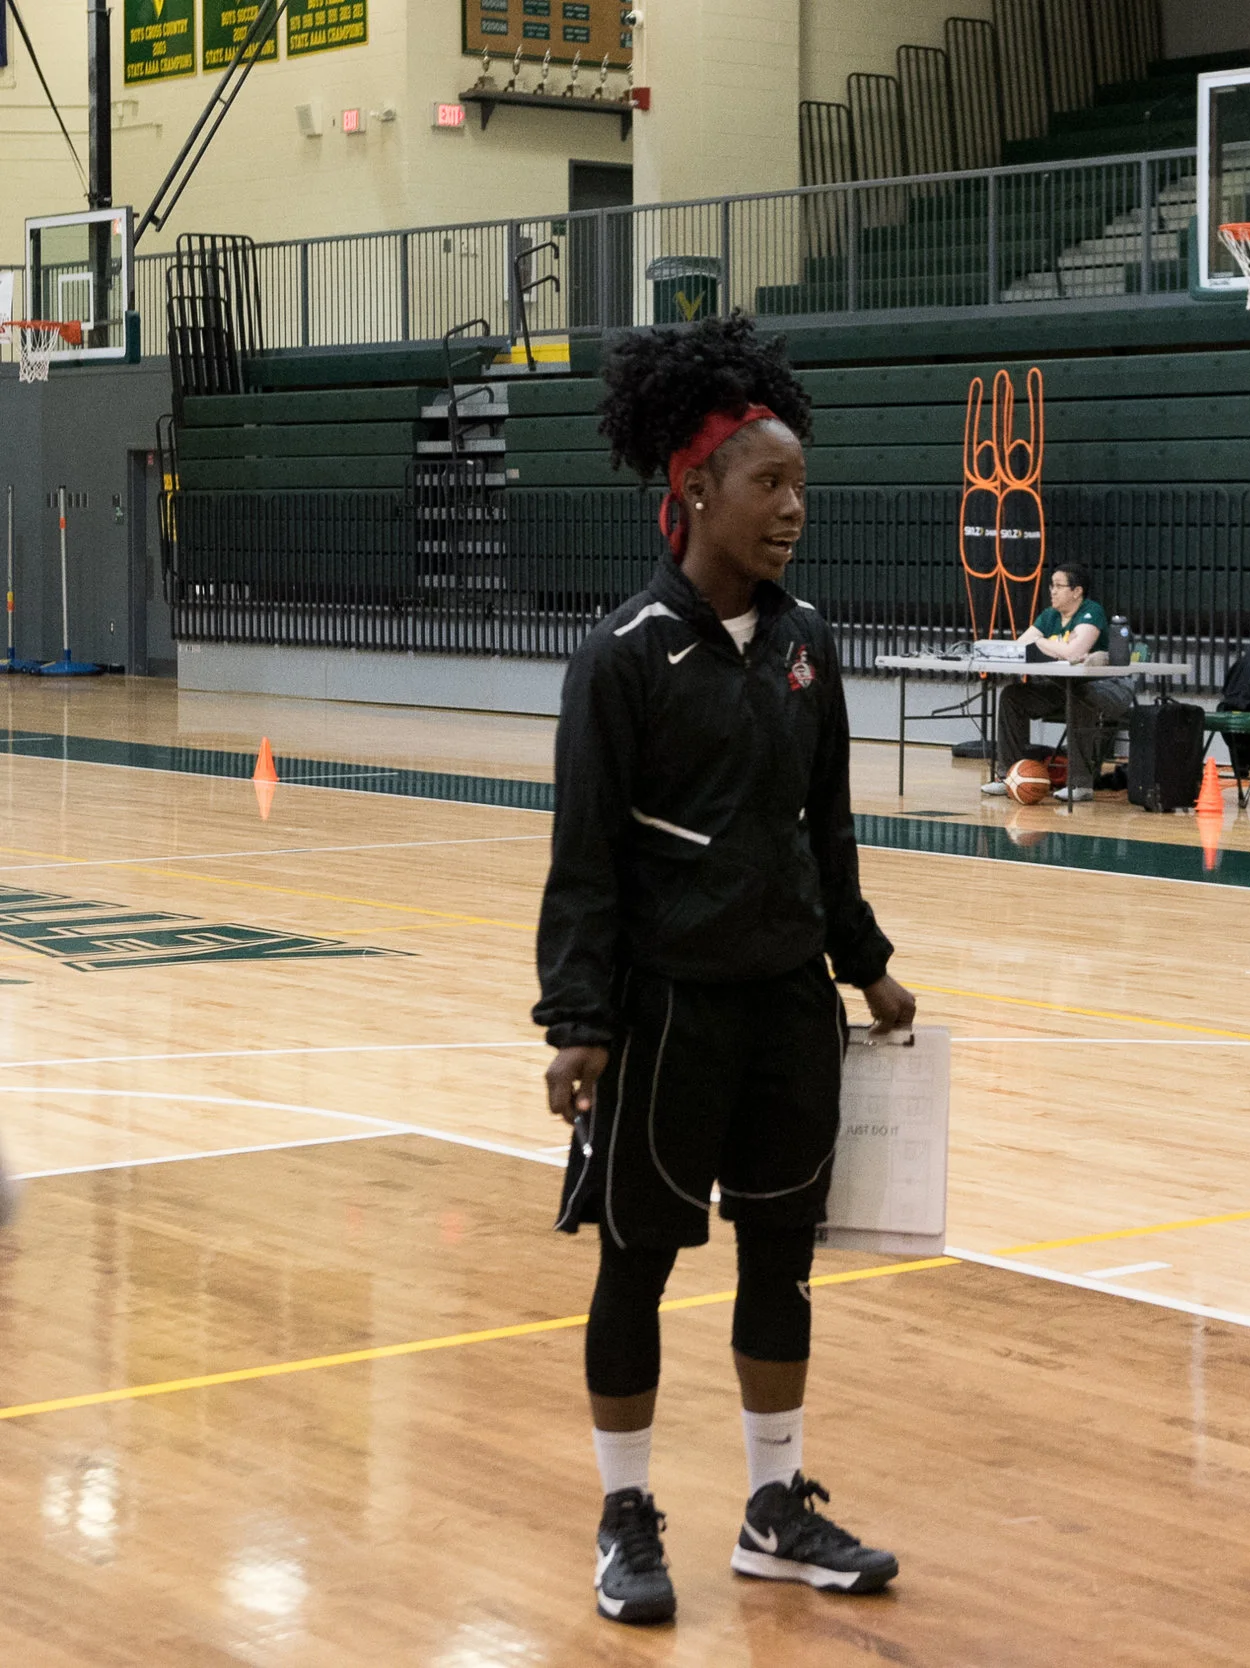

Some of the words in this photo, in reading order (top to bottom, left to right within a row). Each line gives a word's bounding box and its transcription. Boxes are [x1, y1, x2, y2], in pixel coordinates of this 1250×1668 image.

[343, 110, 358, 131] EXIT
[439, 104, 461, 126] EXIT
[871, 1125, 888, 1137] DO
